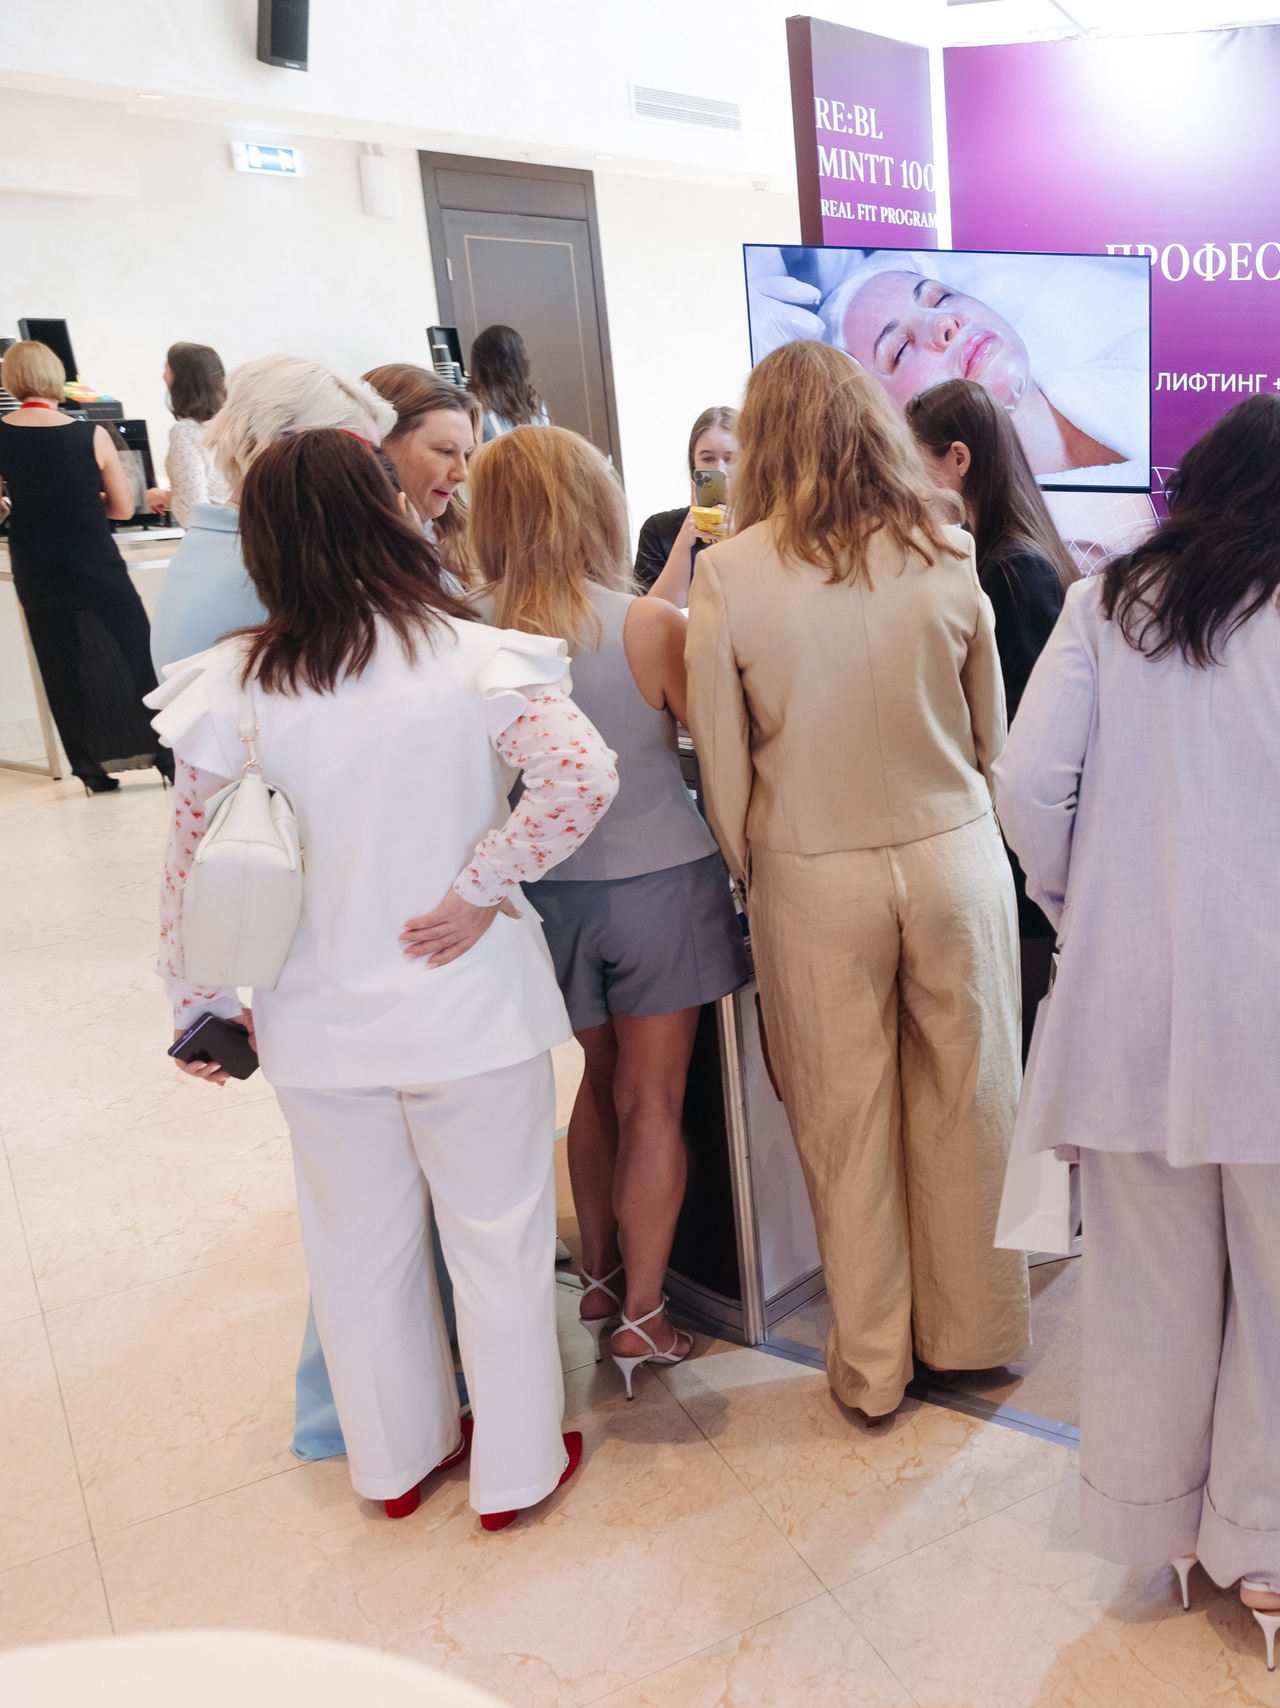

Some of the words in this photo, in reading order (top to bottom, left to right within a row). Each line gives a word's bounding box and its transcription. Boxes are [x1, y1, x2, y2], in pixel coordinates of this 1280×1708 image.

[814, 96, 884, 140] RE:BL
[817, 145, 894, 187] MINTT
[820, 198, 855, 220] REAL
[857, 203, 877, 222] FIT
[880, 206, 937, 229] PROGRAM
[1155, 372, 1268, 393] ЛИФТИНГ
